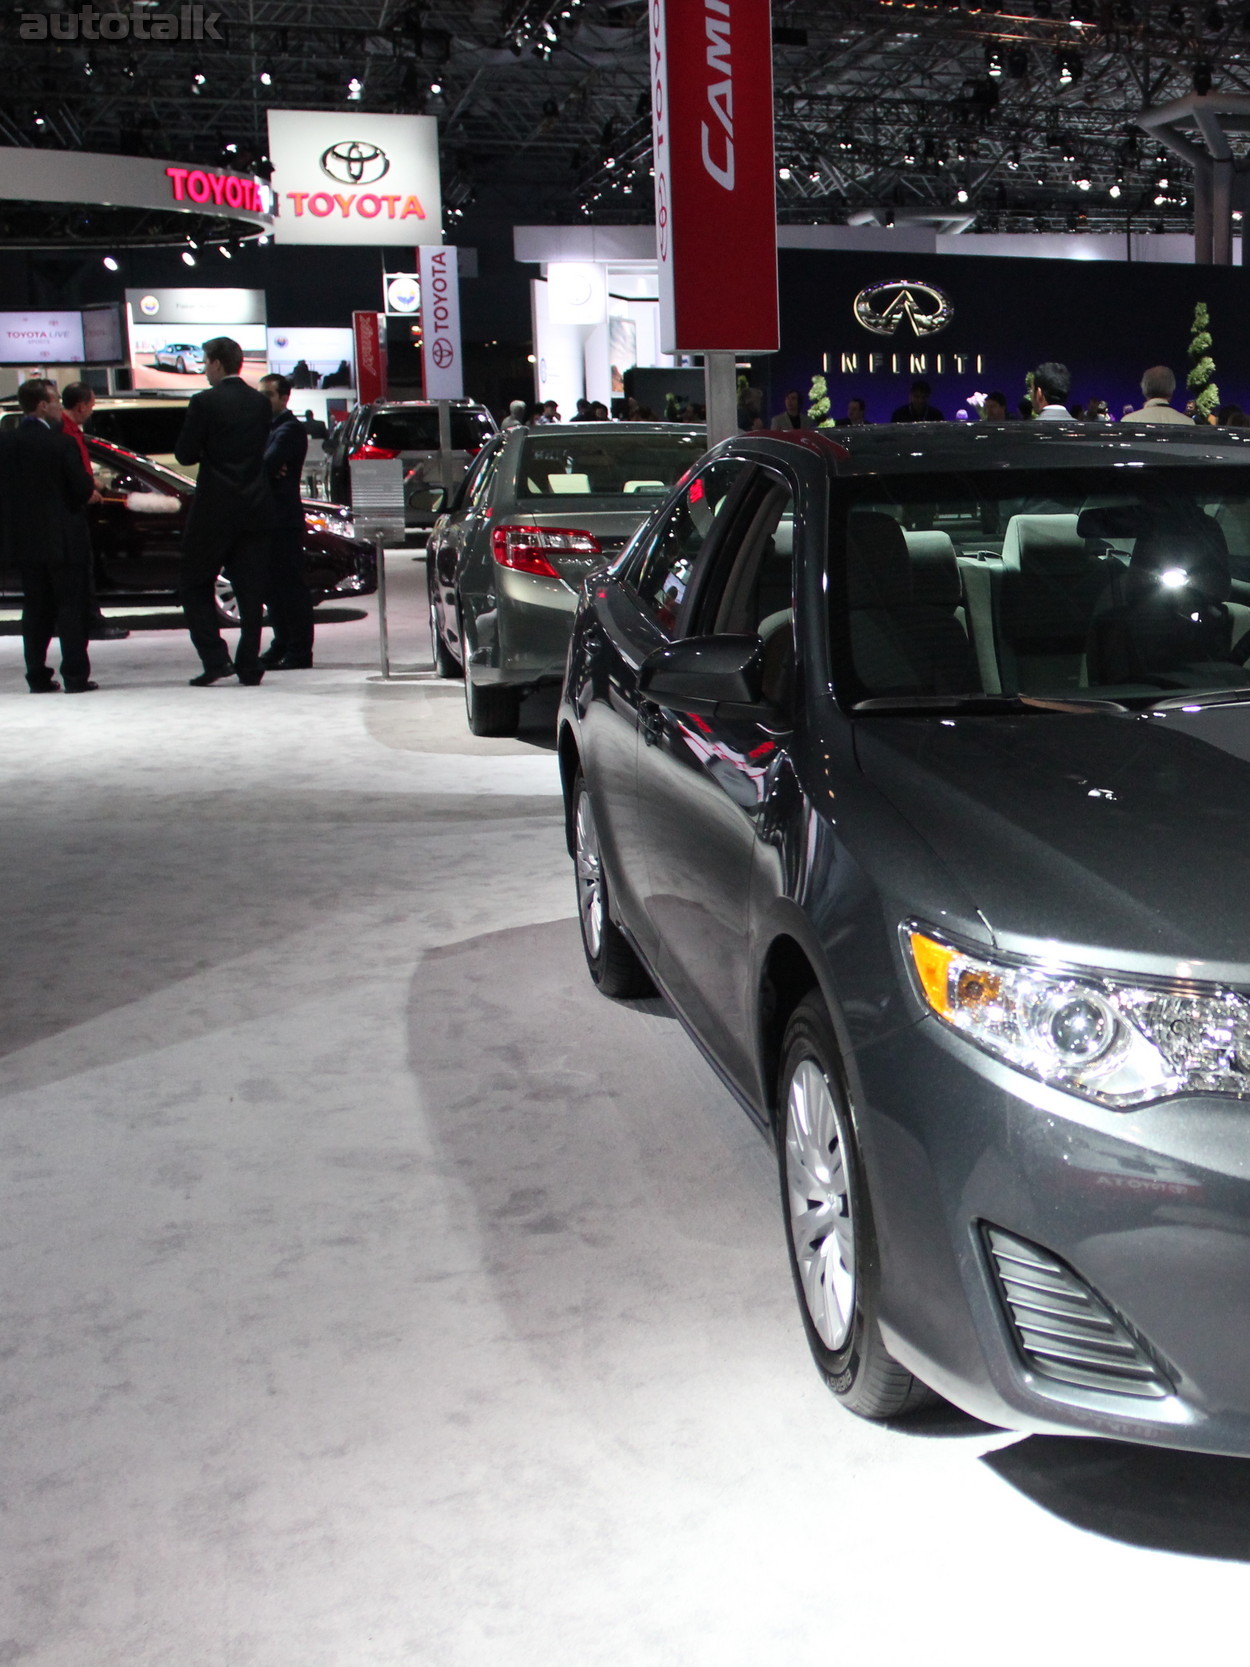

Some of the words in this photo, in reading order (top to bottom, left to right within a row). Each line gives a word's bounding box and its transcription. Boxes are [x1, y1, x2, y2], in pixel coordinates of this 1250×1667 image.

[166, 167, 264, 214] TOYOTA
[286, 191, 427, 220] TOYOTA
[431, 251, 450, 334] TOYOTA
[822, 351, 985, 375] INFINITI
